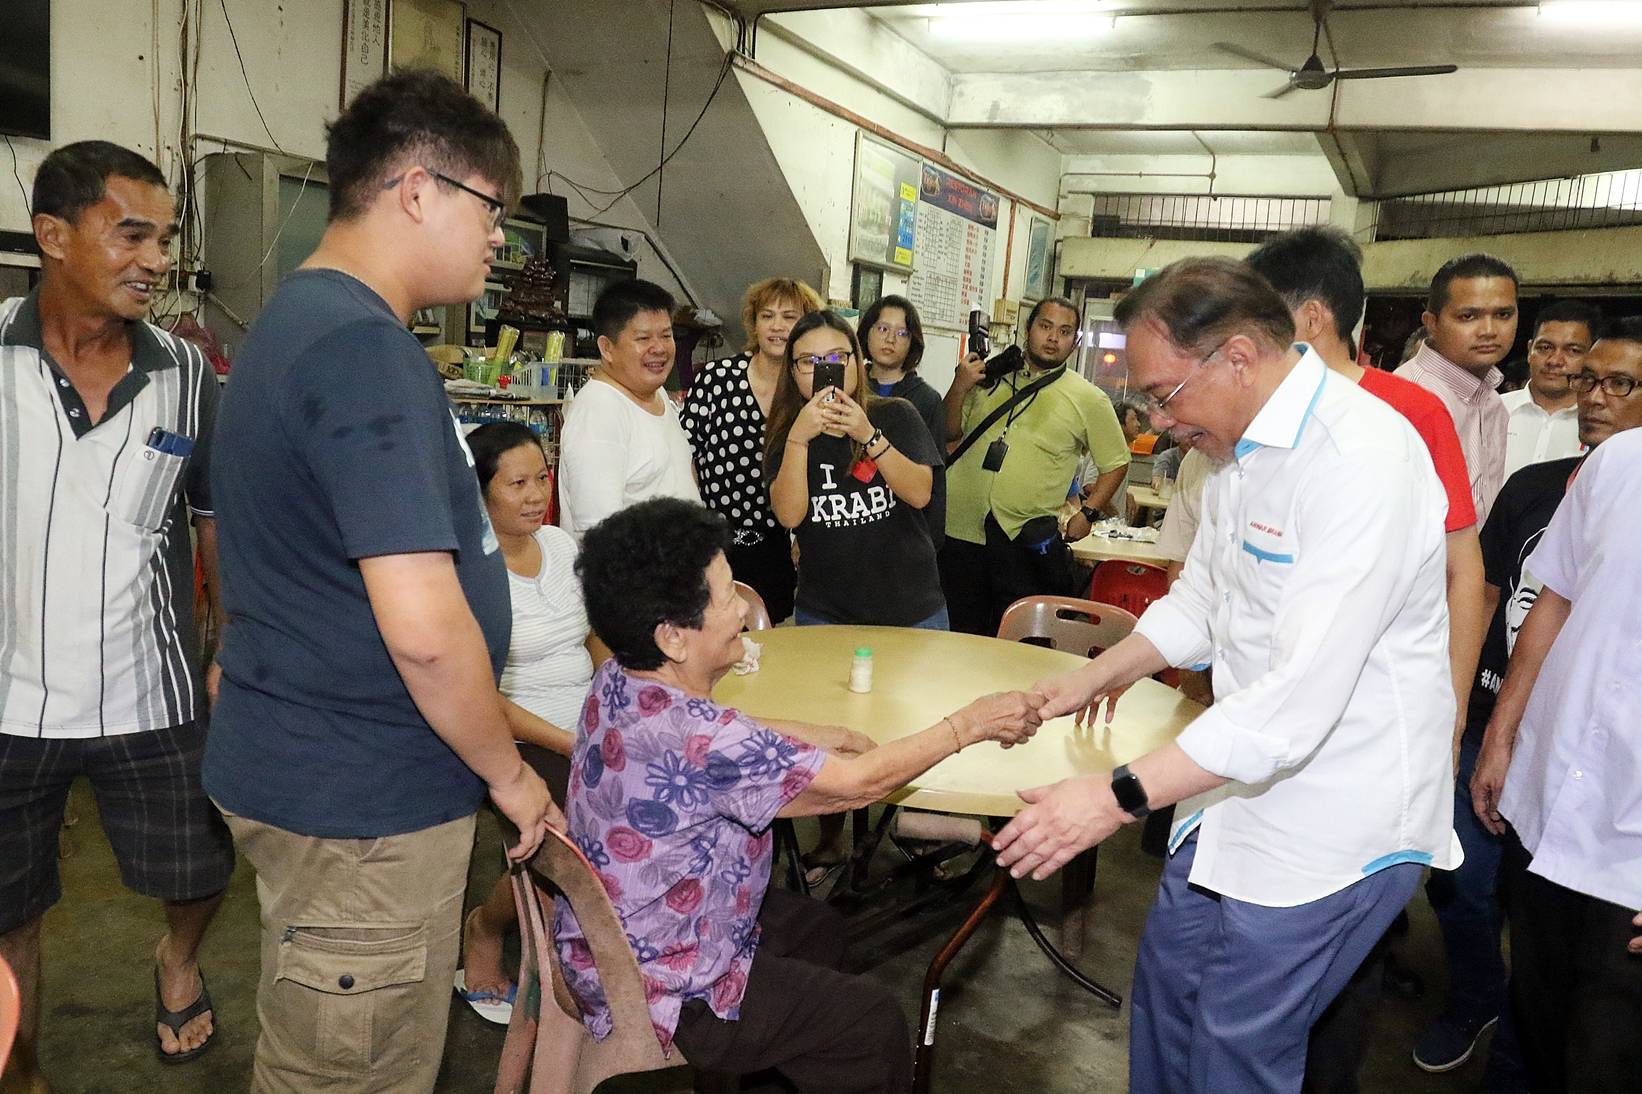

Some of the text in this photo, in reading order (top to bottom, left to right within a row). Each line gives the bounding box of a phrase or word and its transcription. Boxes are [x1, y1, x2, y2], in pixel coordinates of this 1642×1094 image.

[819, 463, 838, 490] I
[811, 485, 896, 522] KRABI
[825, 510, 891, 528] THAILAND
